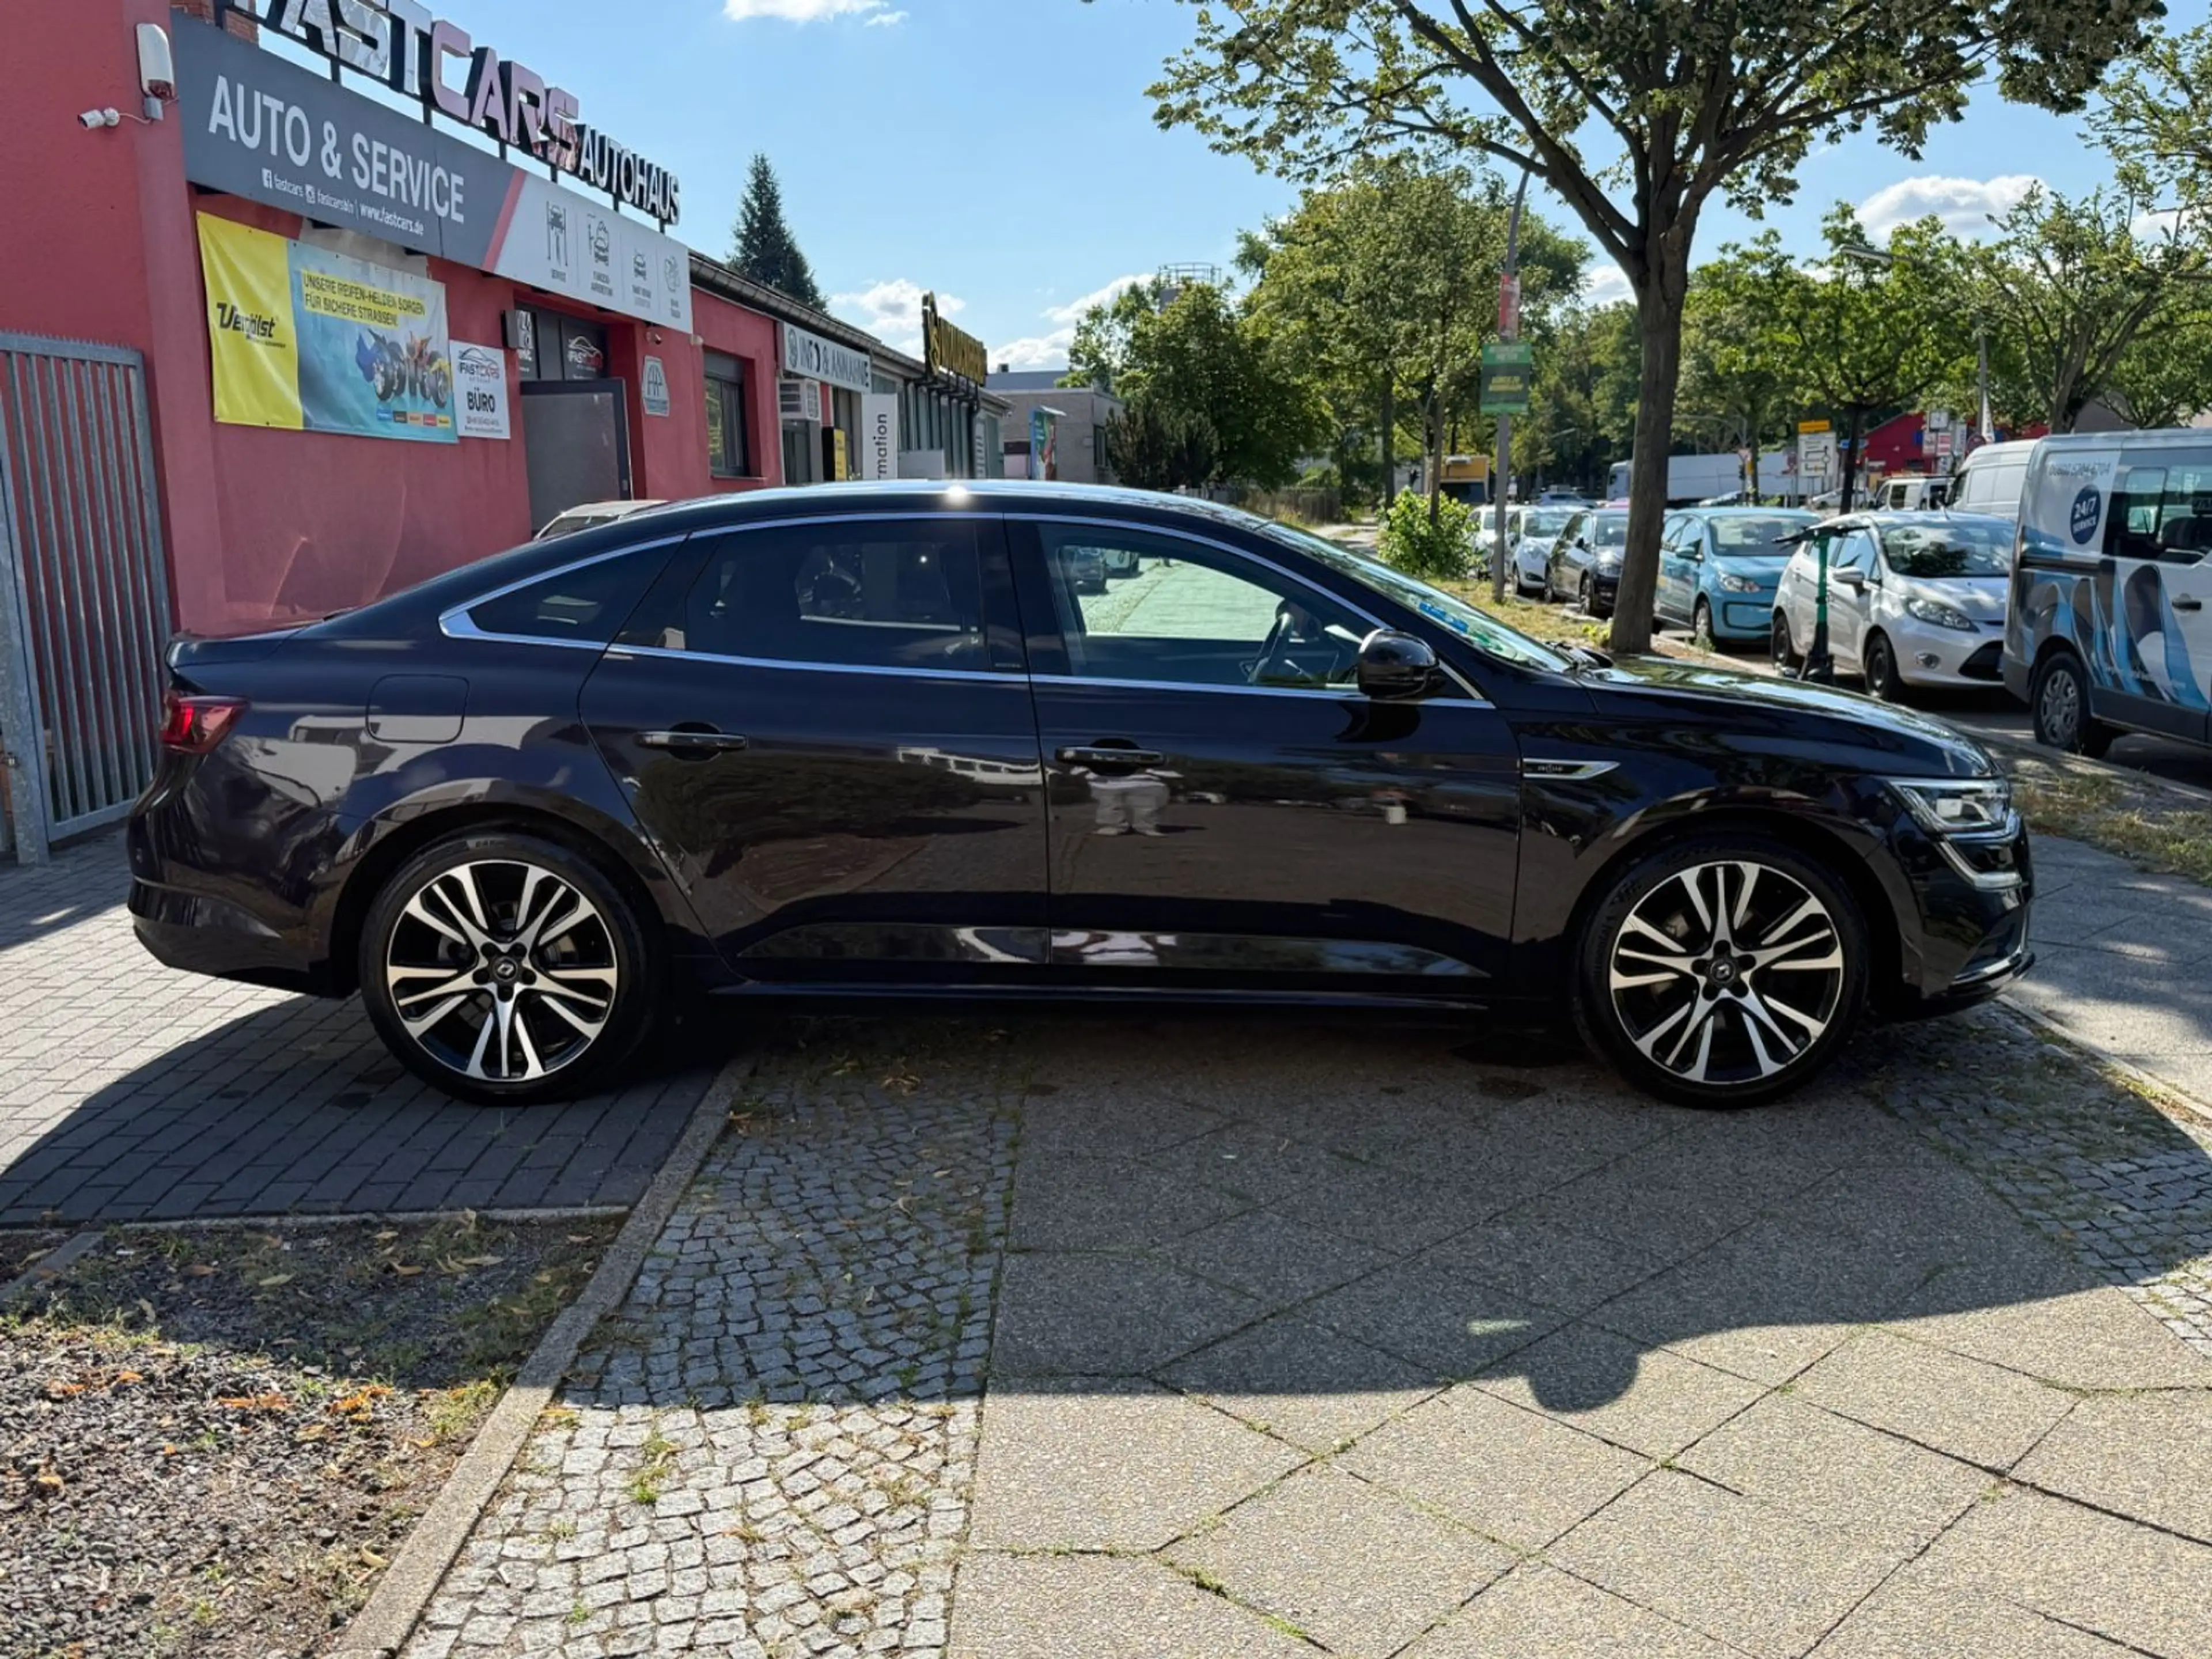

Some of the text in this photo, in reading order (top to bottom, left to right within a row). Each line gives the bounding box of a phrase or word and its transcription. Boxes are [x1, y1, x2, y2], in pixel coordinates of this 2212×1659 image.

[208, 75, 464, 224] AUTO & SERVICE
[578, 124, 681, 225] AUTOHAUS
[359, 202, 425, 237] www.fastcars.de
[304, 273, 426, 316] UNSERE REIFEN-HELDEN SORGEN
[305, 293, 321, 310] FÜR
[323, 297, 358, 319] SICHERE
[466, 387, 497, 414] BÜRO
[2074, 495, 2097, 520] 24/7
